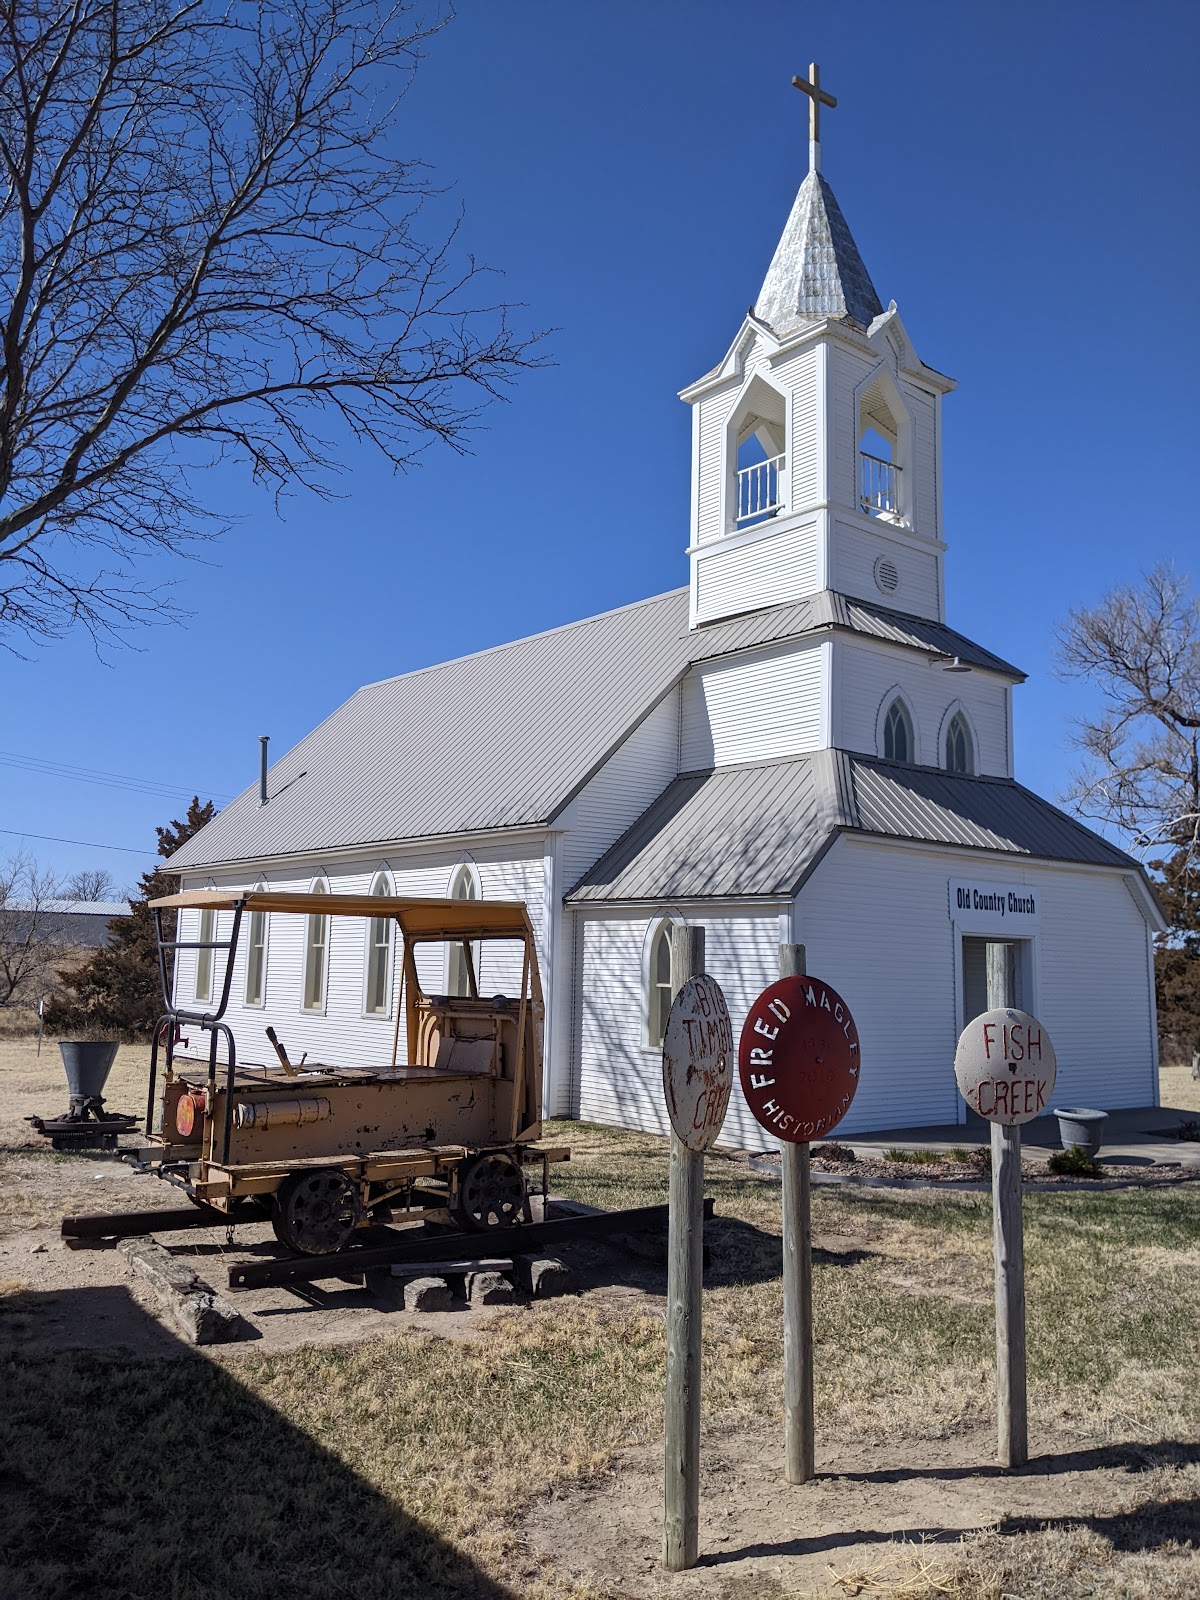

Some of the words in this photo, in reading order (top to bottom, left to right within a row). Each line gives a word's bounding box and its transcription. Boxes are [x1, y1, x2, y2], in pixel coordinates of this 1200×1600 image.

[957, 887, 971, 910] Old
[973, 888, 1006, 917] Country
[1007, 891, 1036, 914] Church
[695, 982, 727, 1018] BIG
[750, 998, 791, 1090] FRED
[801, 984, 859, 1079] MAGLEY
[983, 1023, 1042, 1061] FISH
[976, 1079, 1047, 1117] CREEK
